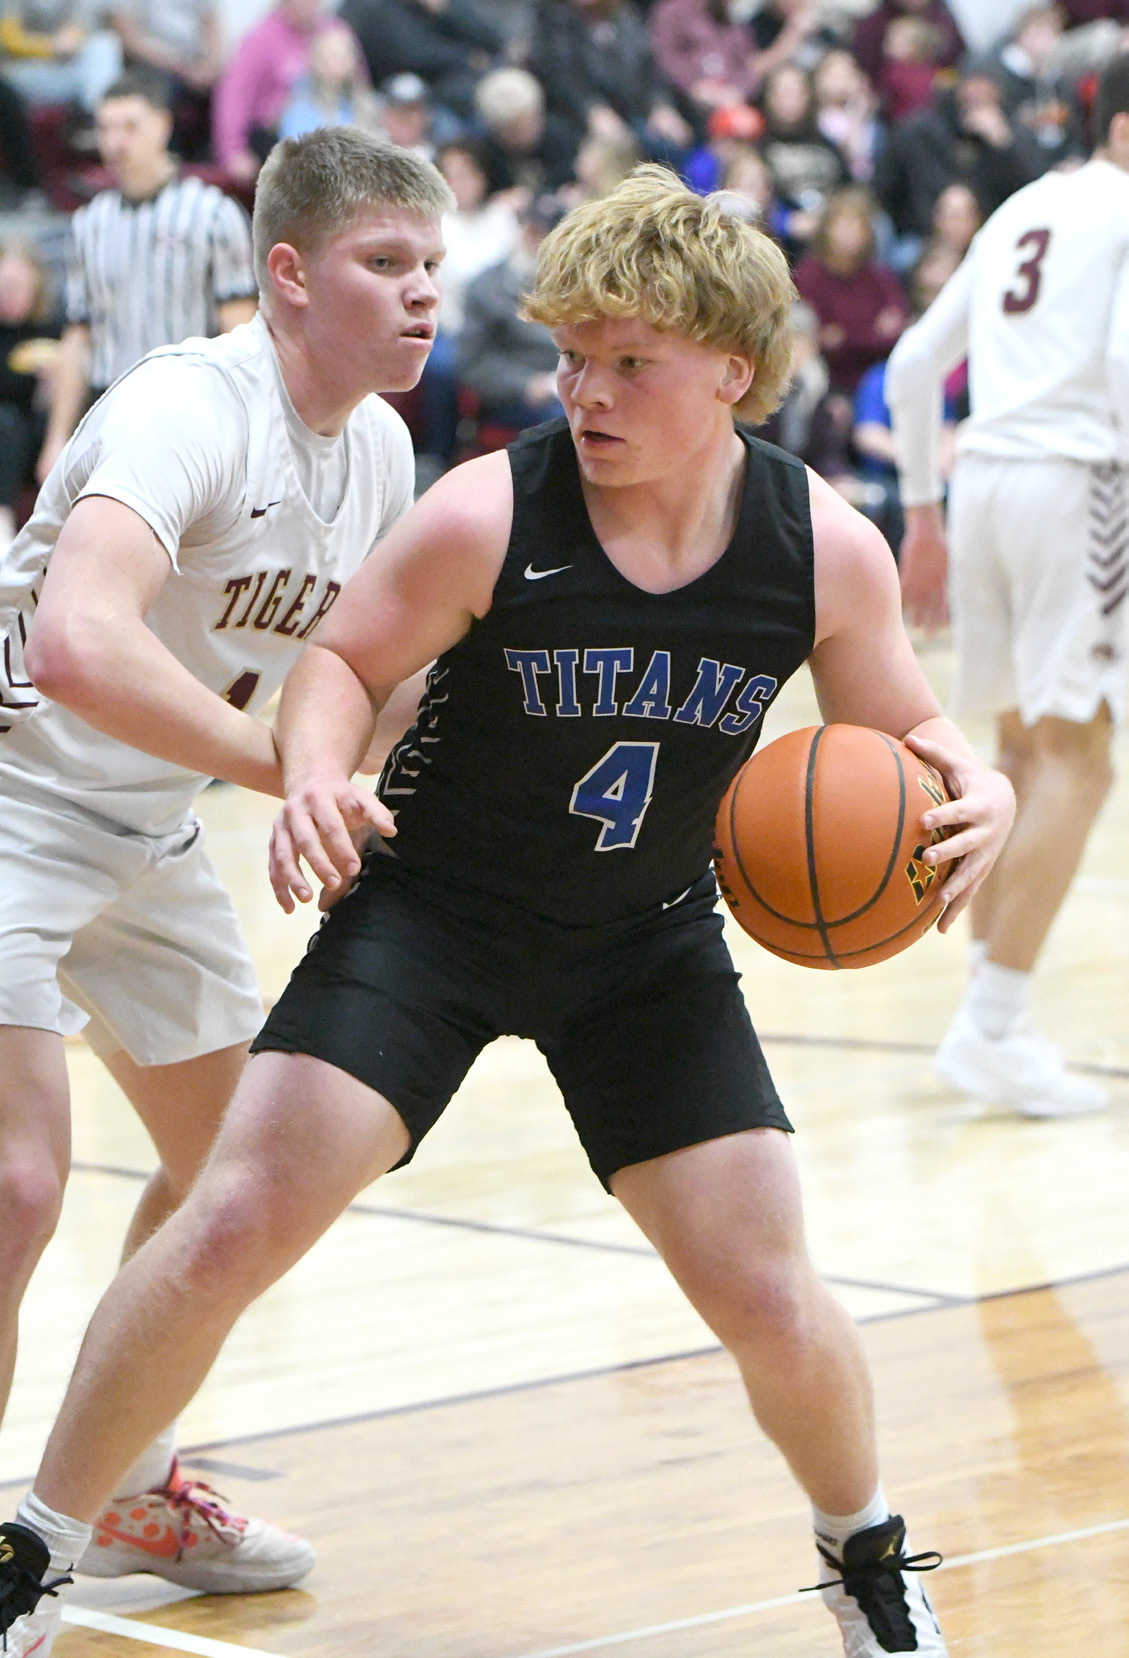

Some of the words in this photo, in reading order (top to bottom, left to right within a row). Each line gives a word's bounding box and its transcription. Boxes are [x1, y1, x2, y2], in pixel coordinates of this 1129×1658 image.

[1002, 228, 1050, 314] 3
[503, 647, 778, 736] TITANS
[568, 741, 660, 851] 4
